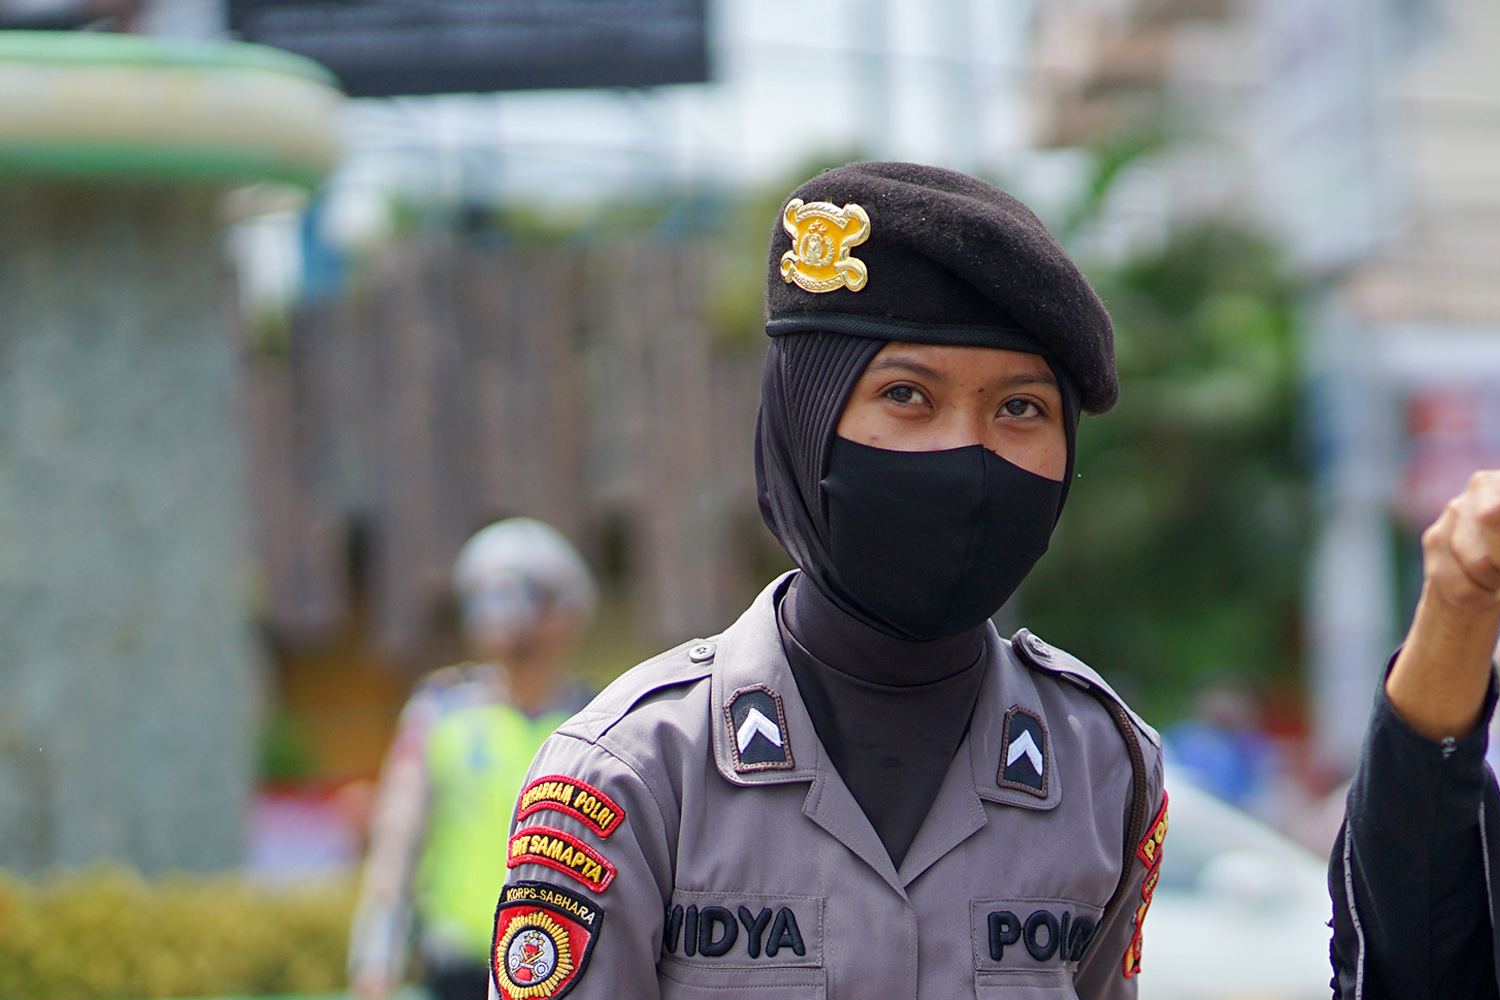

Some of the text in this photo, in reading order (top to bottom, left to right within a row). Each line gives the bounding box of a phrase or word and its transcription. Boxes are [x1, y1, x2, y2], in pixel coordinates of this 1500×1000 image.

[573, 791, 616, 830] POLRI
[529, 835, 602, 883] SAMAPTA
[506, 887, 595, 925] KORPS SABHARA
